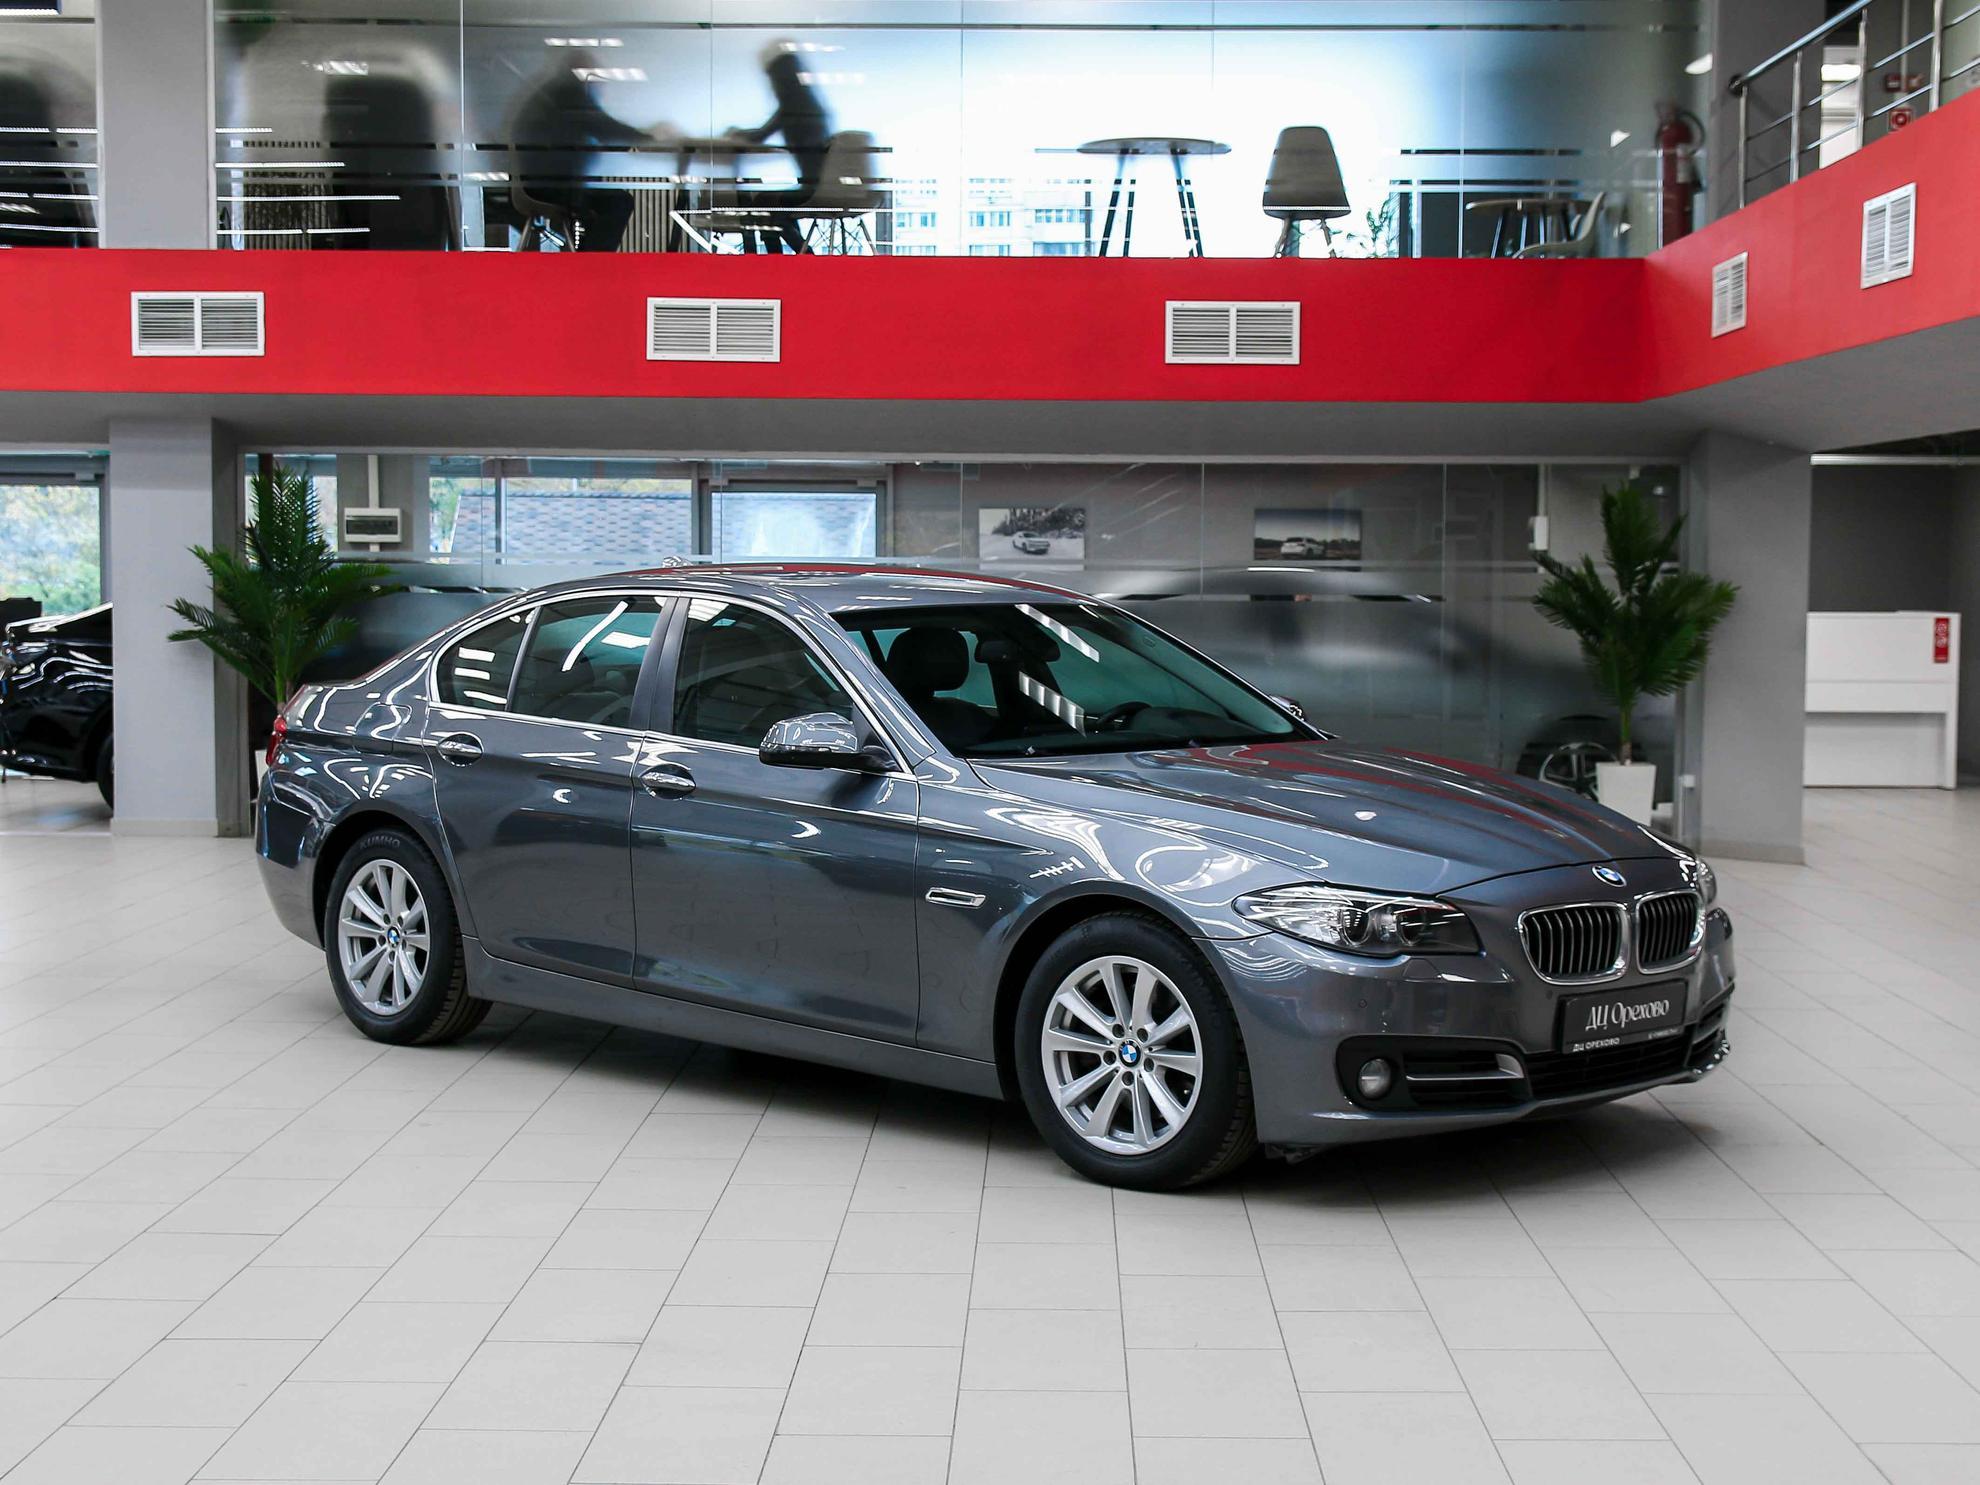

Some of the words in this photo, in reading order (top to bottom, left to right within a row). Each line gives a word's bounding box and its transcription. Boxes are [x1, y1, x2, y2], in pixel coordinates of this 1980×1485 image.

[360, 835, 401, 849] KUMHO
[1585, 1004, 1609, 1031] ДЦ
[1611, 999, 1670, 1028] Орехово
[1585, 1037, 1621, 1050] ОРЕХОВО
